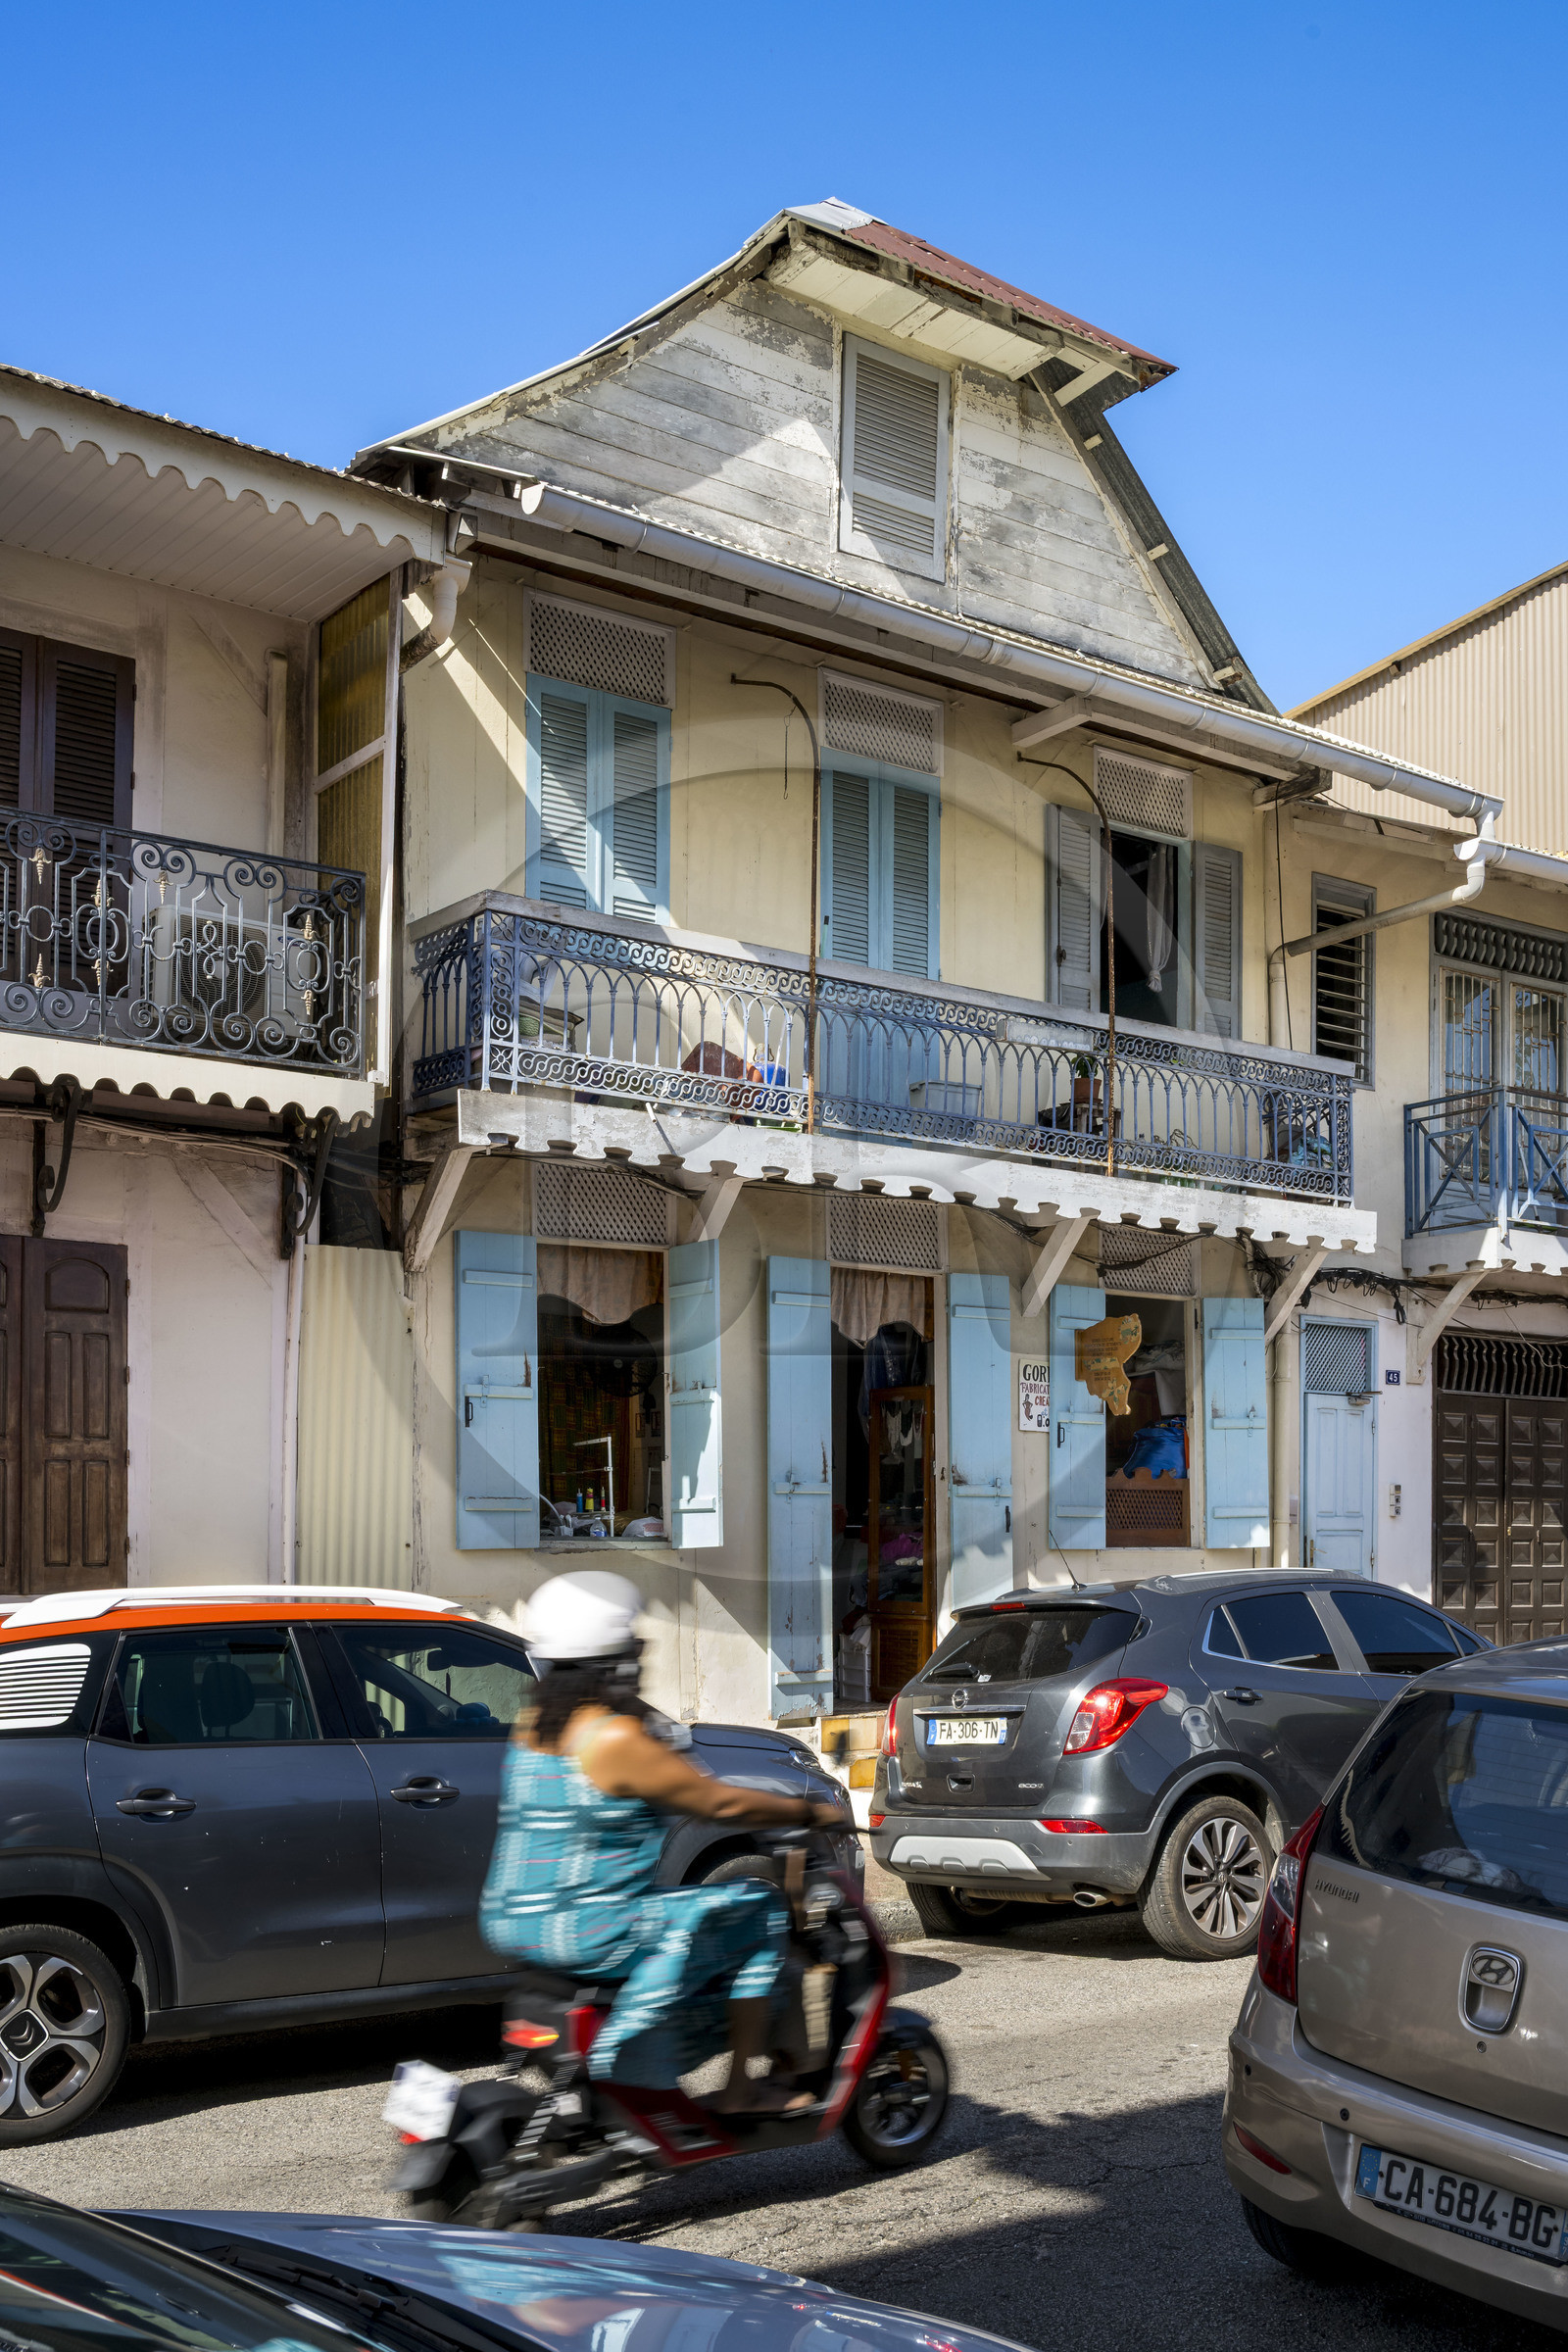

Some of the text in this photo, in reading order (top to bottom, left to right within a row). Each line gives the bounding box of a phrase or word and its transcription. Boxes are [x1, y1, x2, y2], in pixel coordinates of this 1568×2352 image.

[1389, 1373, 1398, 1382] 45
[939, 1721, 999, 1740] FA-306-TN
[1314, 1879, 1359, 1903] HYUNDAI
[1362, 2177, 1371, 2188] F
[1384, 2159, 1556, 2248] CA-684-BG
